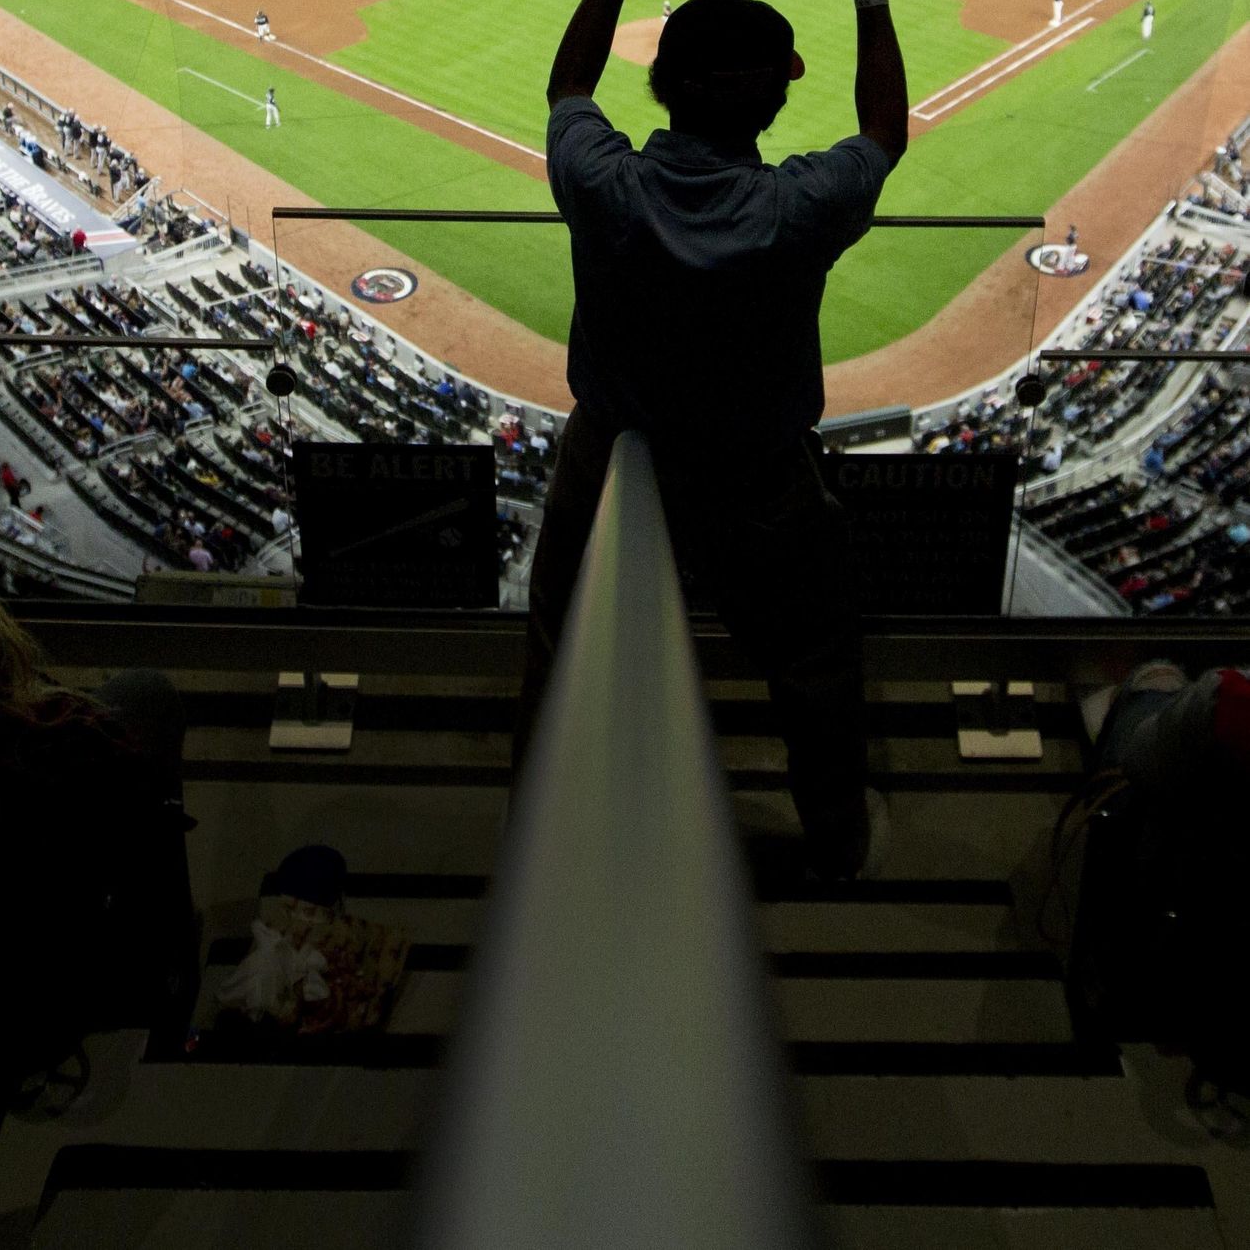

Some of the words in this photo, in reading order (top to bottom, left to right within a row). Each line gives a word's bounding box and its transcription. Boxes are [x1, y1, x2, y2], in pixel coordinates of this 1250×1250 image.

[310, 452, 357, 479] BE
[368, 452, 478, 481] ALERT
[837, 462, 996, 491] CAUTION
